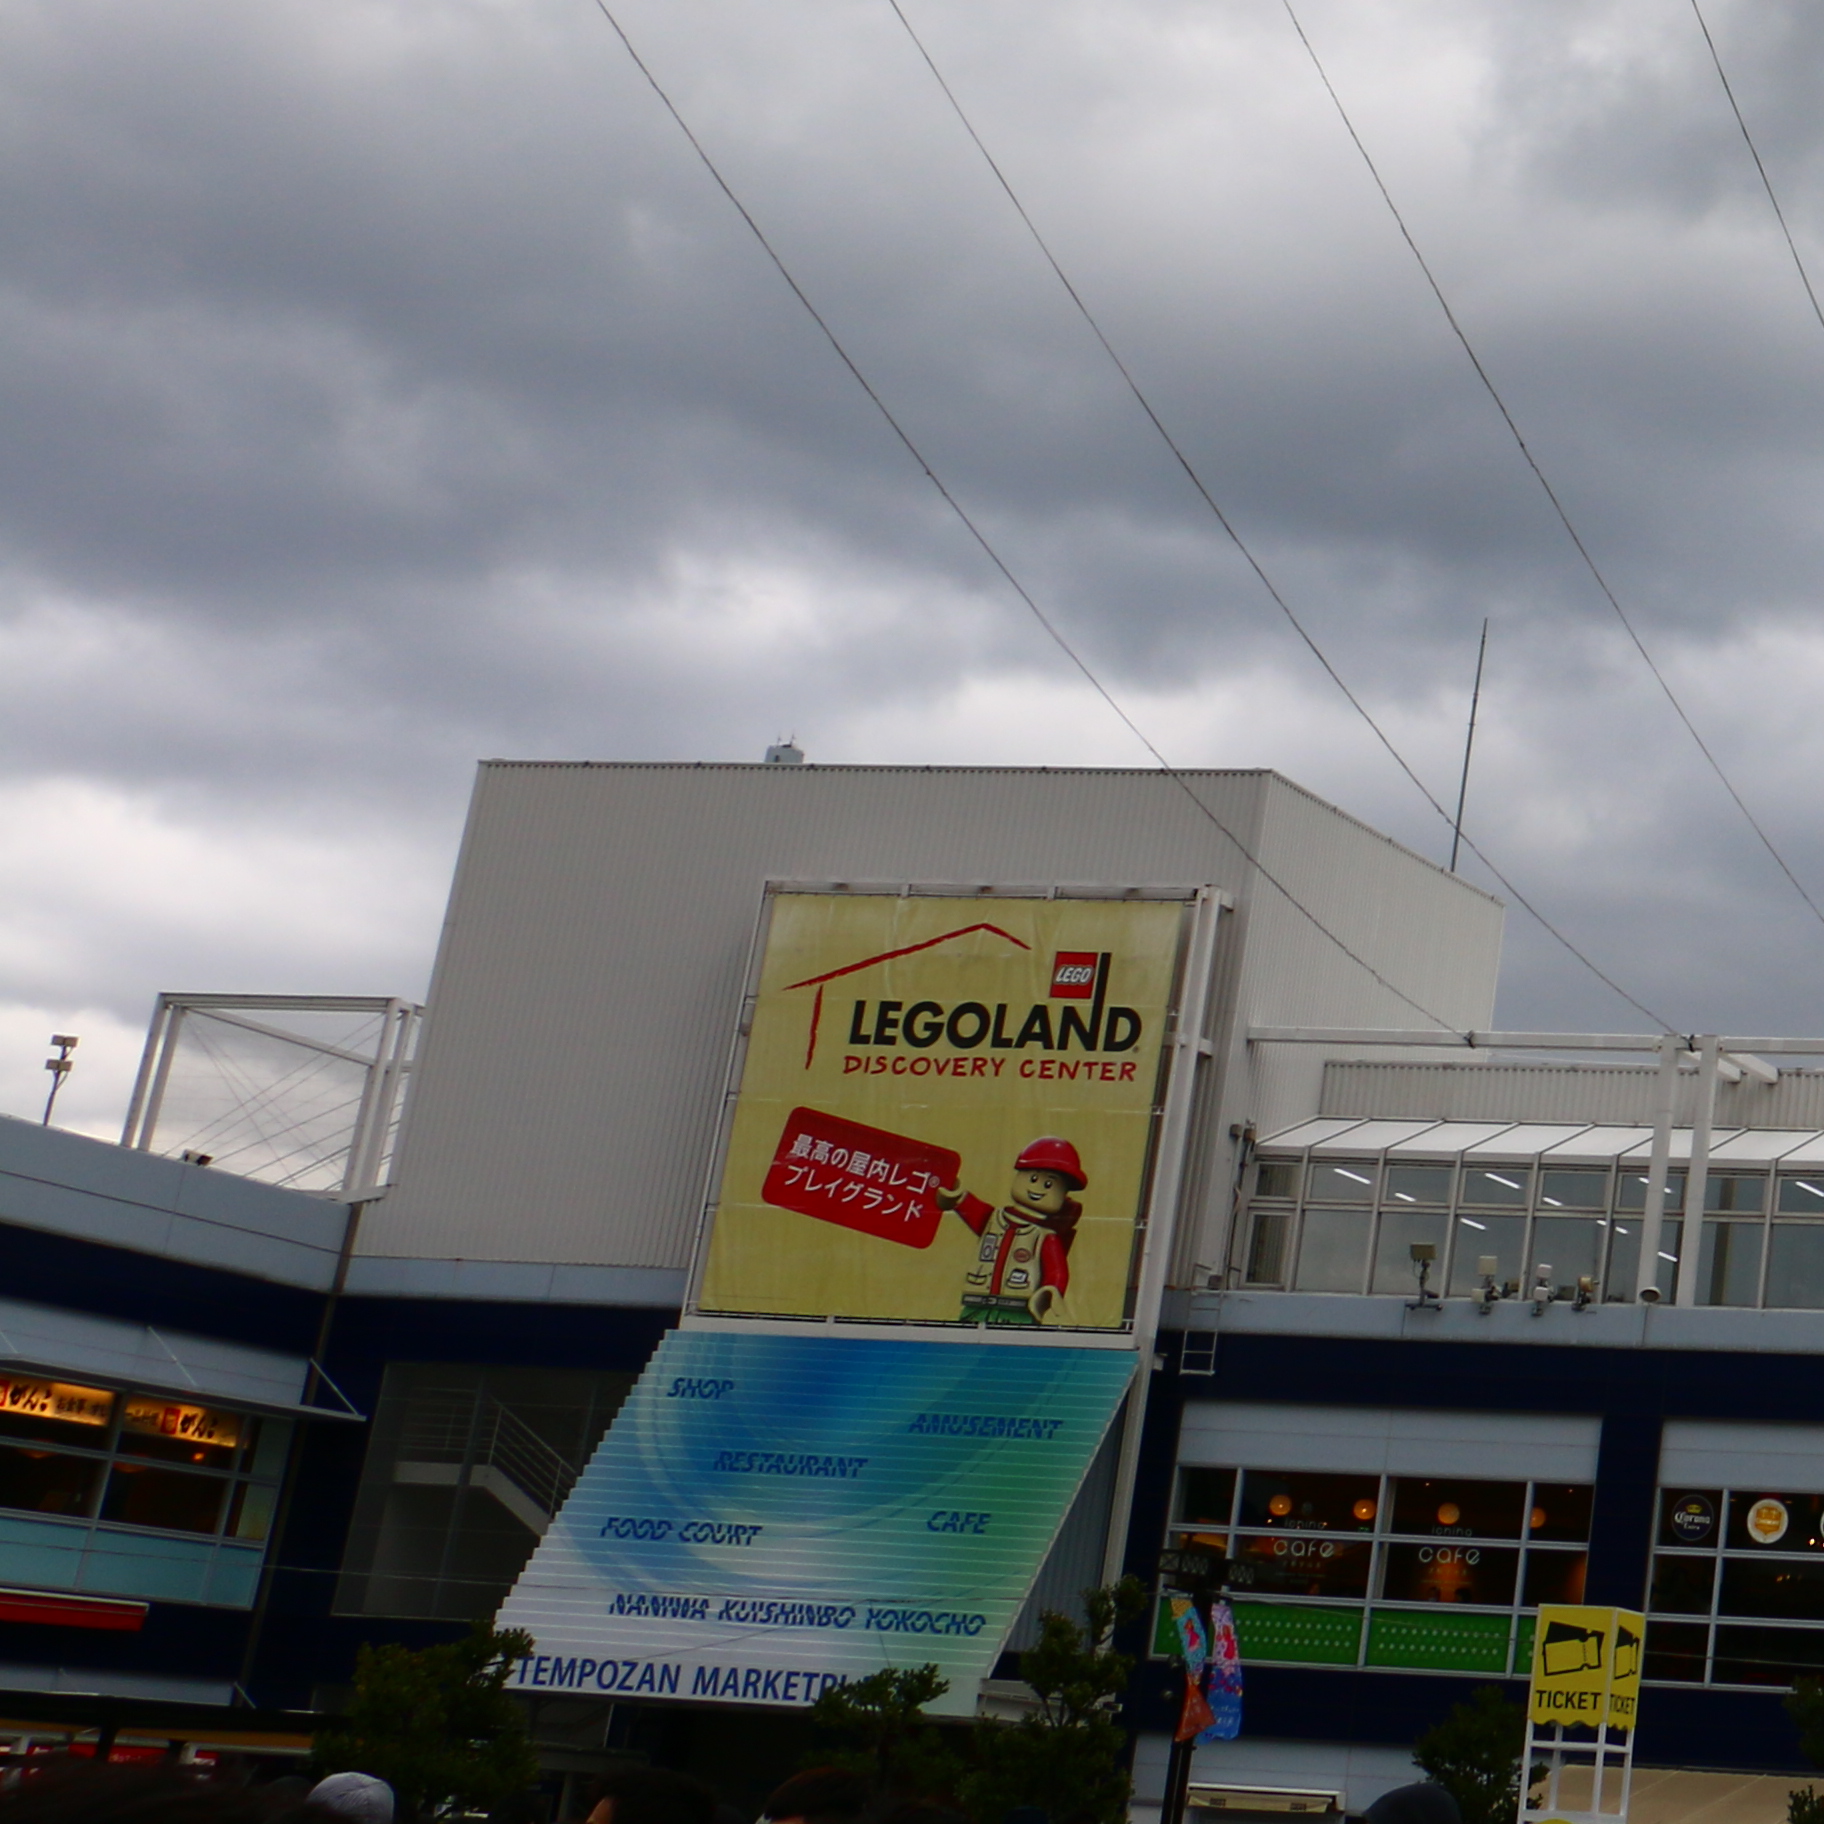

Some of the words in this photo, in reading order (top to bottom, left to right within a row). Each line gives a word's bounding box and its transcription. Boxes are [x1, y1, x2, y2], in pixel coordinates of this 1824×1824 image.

[1054, 966, 1093, 985] LEGO
[849, 954, 1143, 1053] LEGOLAND
[843, 1055, 1006, 1077] DISCOVERY
[1018, 1058, 1138, 1081] CENTER
[784, 1164, 924, 1223] プレイグランド
[667, 1377, 735, 1400] SHOP
[908, 1412, 1064, 1439] AMUSEMENT
[713, 1450, 870, 1478] RESTAURANT
[601, 1517, 673, 1541] FOOD
[678, 1520, 764, 1546] COURT
[926, 1510, 992, 1535] CAFE
[1273, 1538, 1335, 1559] cafe
[1418, 1545, 1481, 1566] cafe
[609, 1593, 711, 1620] NANIWA
[718, 1598, 856, 1629] KUISHINBO
[865, 1607, 987, 1637] YOKOCHO
[516, 1654, 682, 1695] TEMPOZAN
[1535, 1689, 1602, 1711] TICKET
[1609, 1693, 1636, 1716] TICKET
